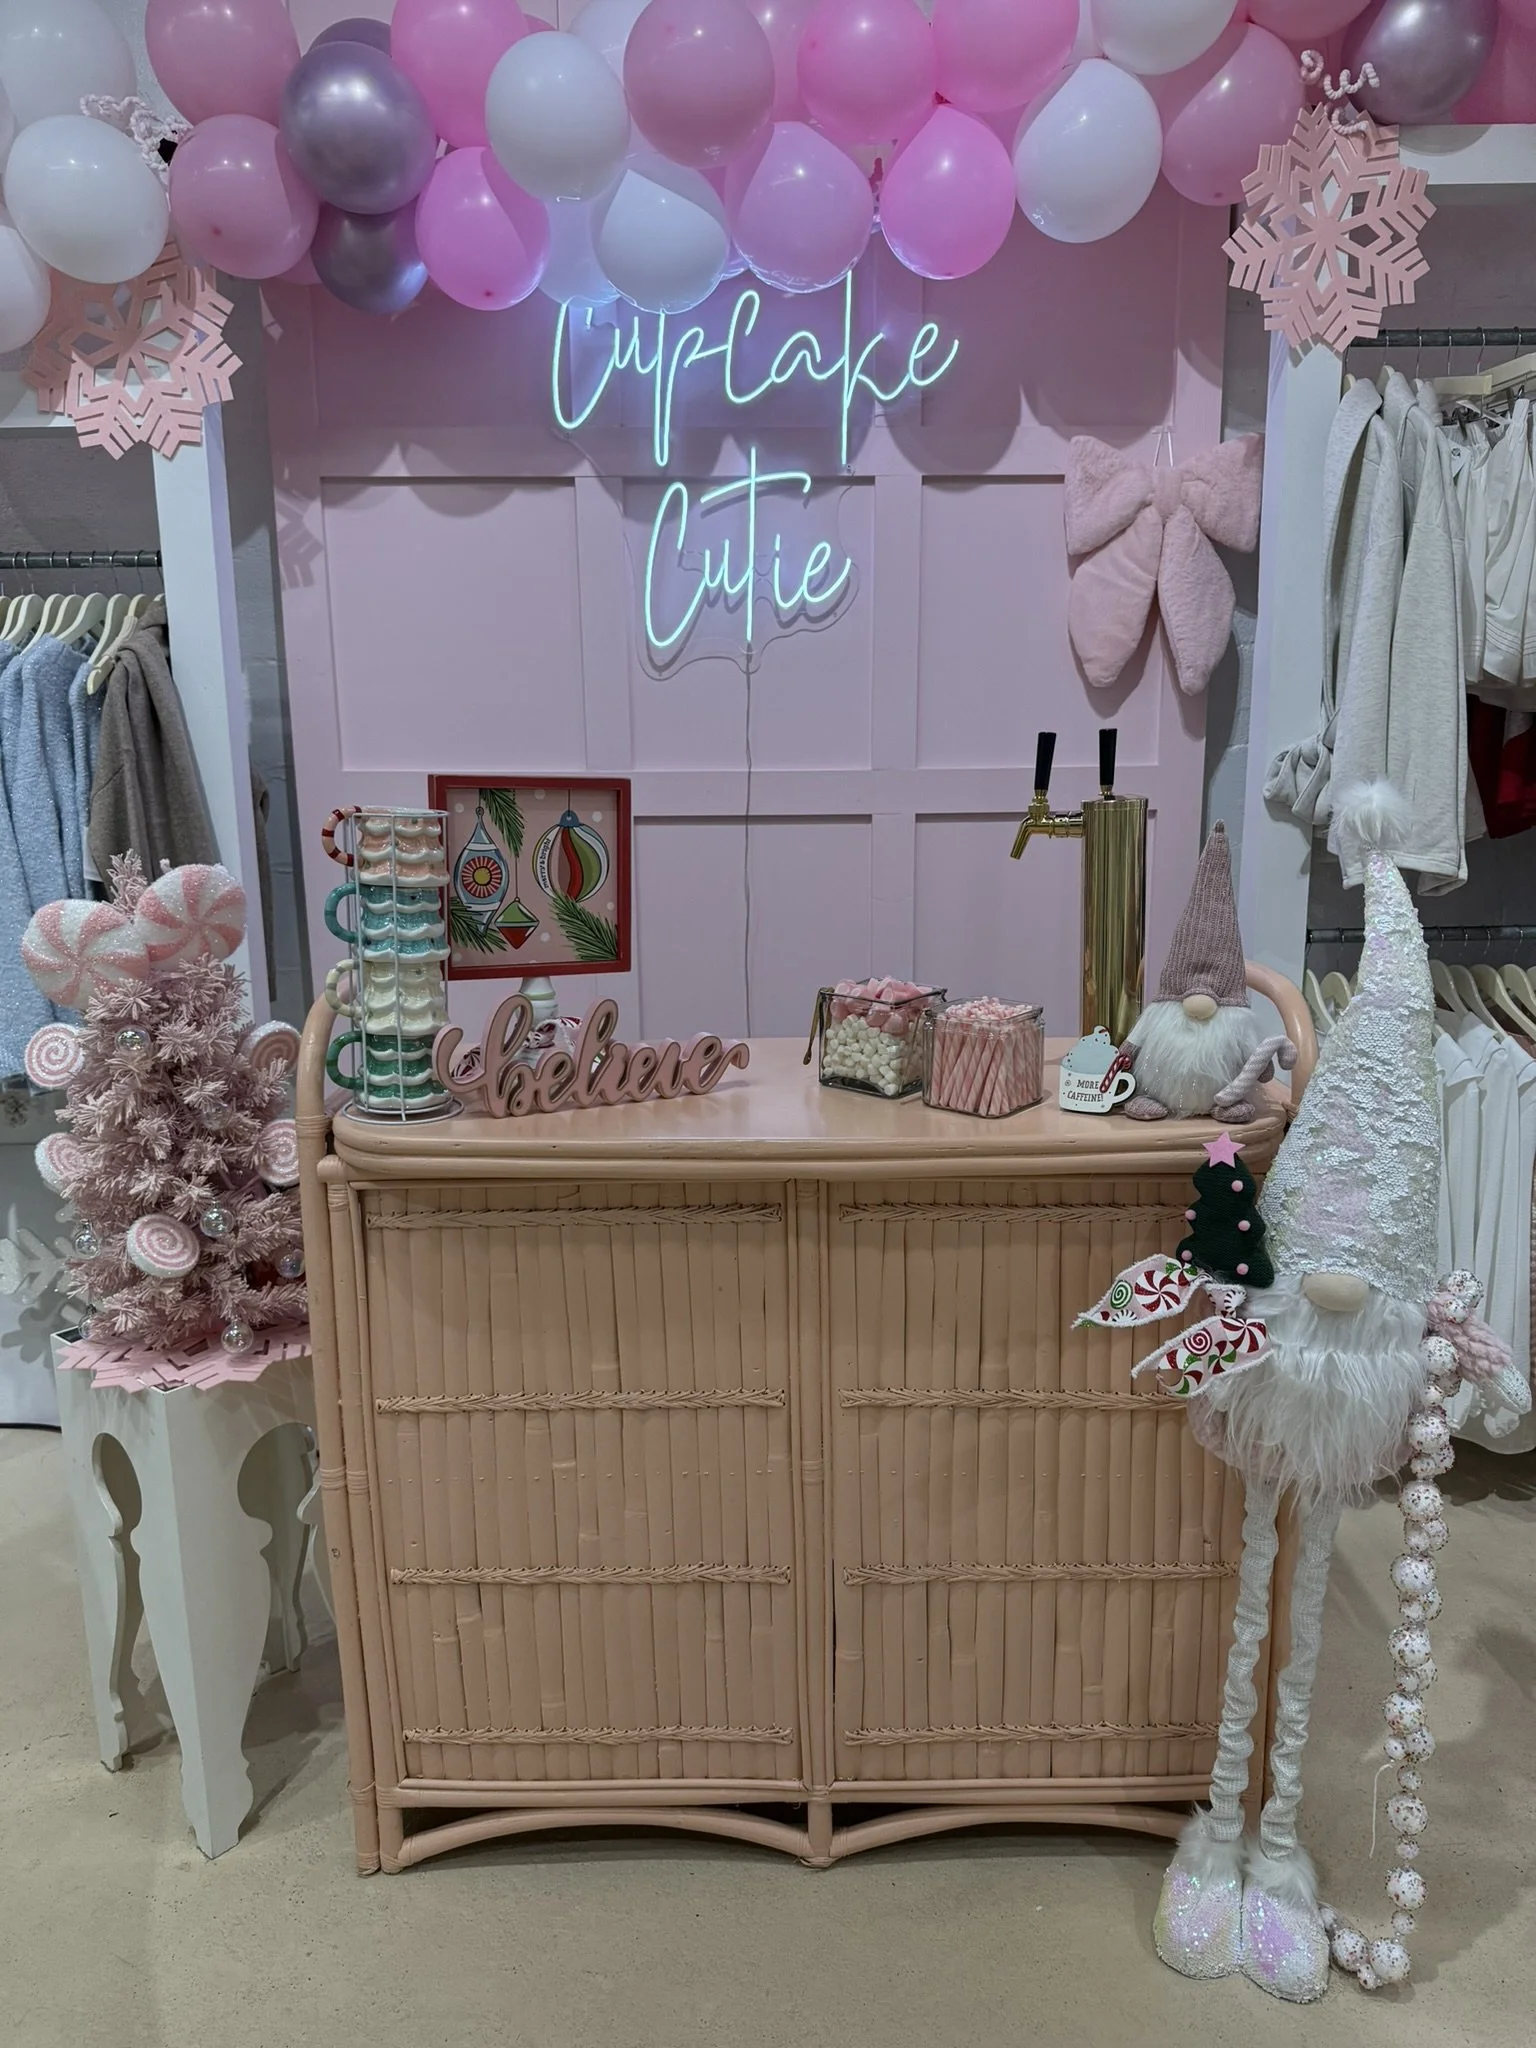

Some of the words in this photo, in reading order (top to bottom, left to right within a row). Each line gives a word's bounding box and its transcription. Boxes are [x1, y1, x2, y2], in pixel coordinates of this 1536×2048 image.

[644, 446, 852, 649] Cutie
[539, 837, 552, 860] bright
[432, 992, 750, 1119] believe
[1076, 1079, 1100, 1090] MORE
[1066, 1090, 1105, 1103] CAFFEINE!
